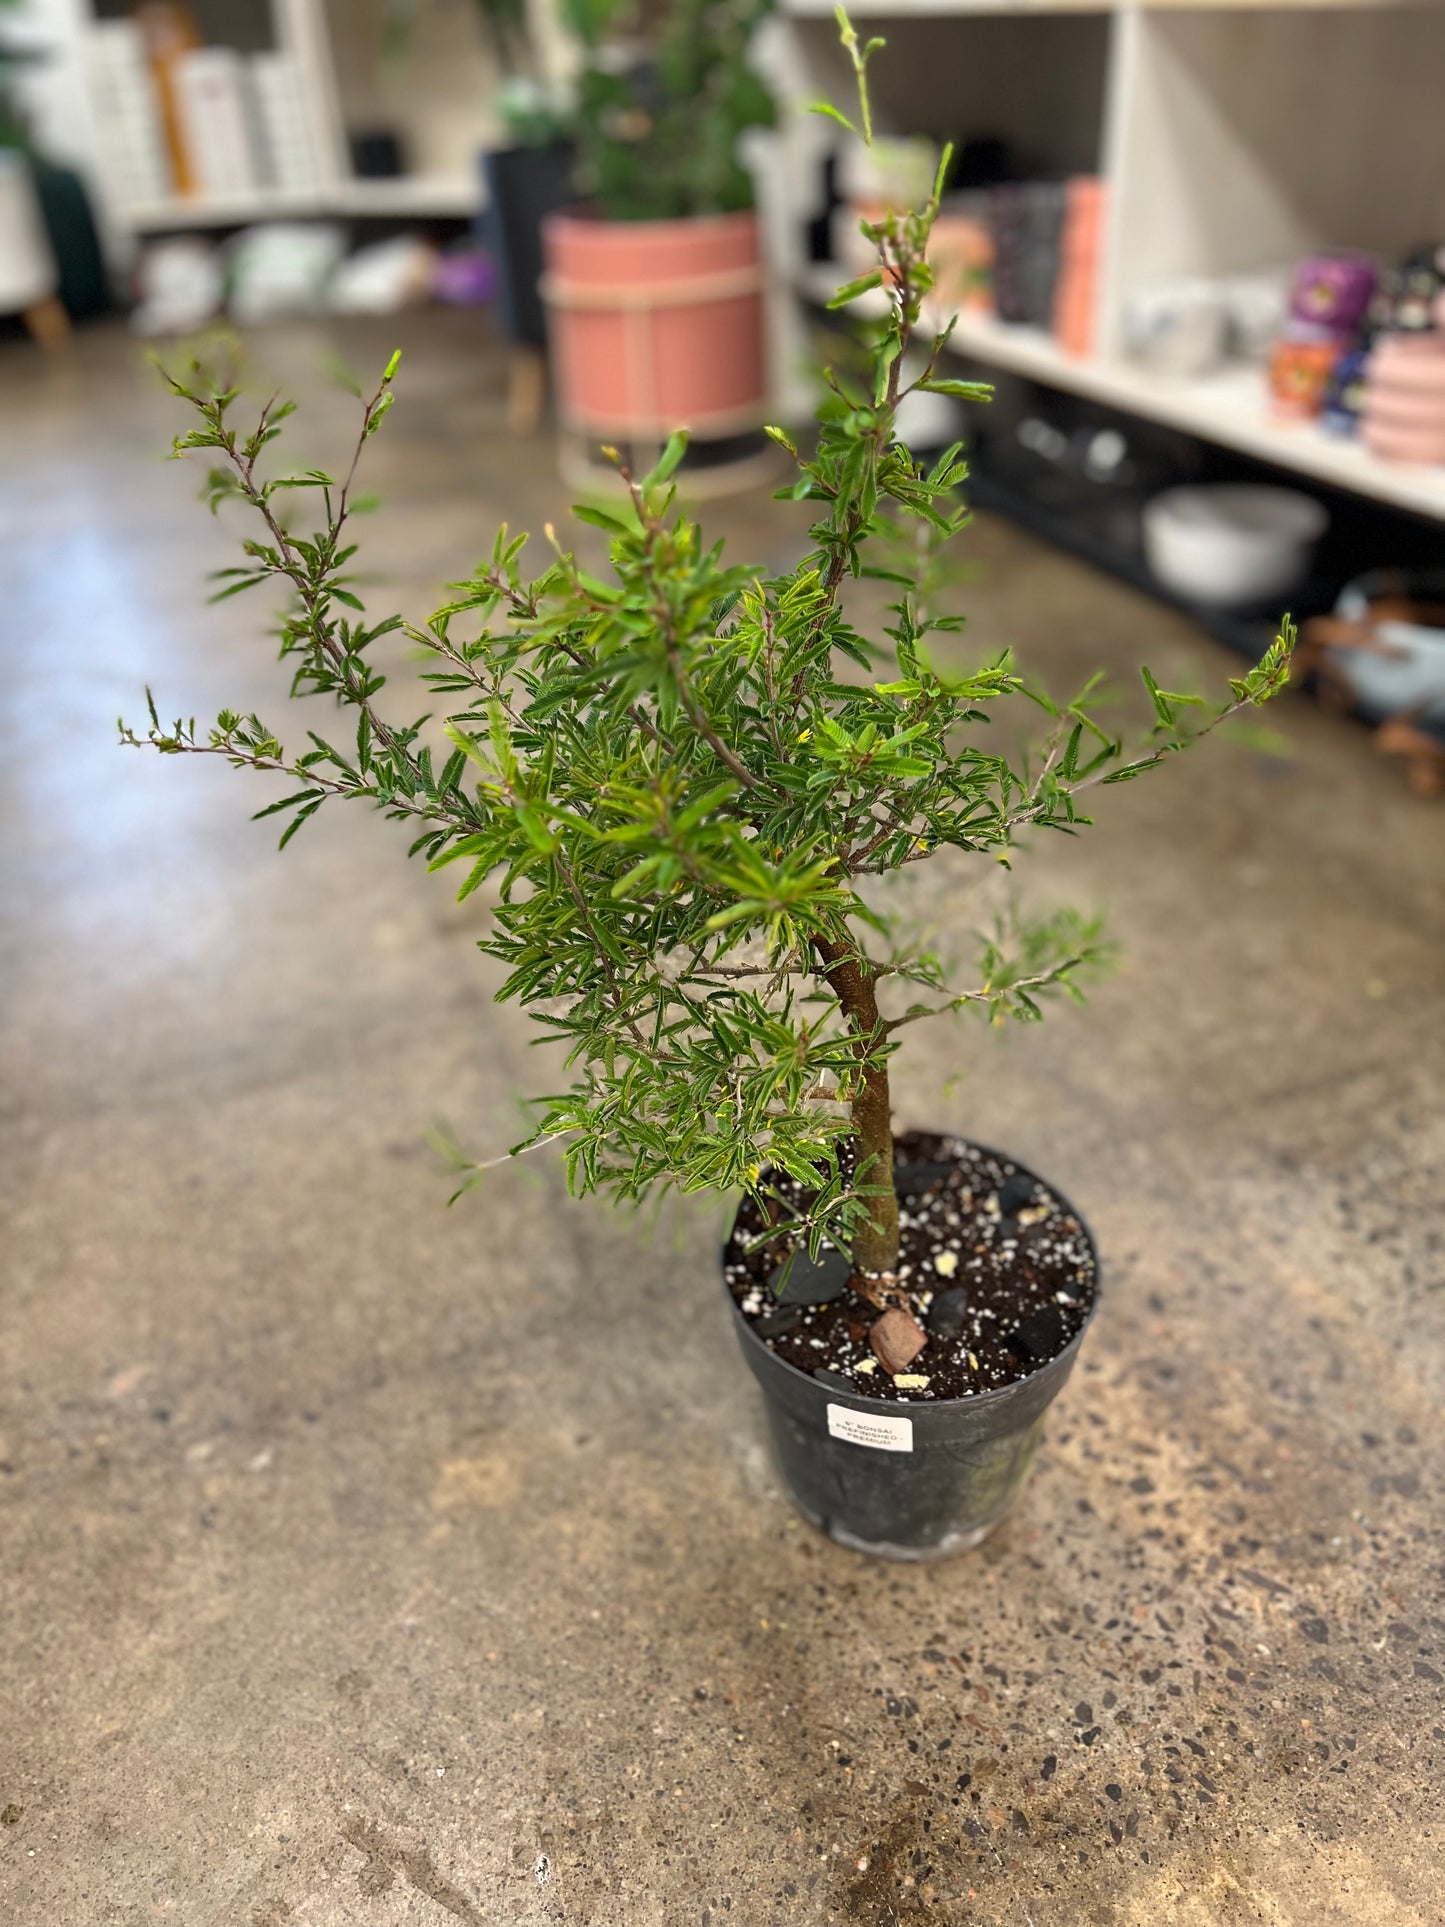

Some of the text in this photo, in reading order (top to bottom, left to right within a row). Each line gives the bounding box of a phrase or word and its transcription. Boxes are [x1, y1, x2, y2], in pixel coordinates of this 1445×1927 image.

[836, 1423, 897, 1440] PREFINISHED
[857, 1424, 892, 1434] BONSAI
[847, 1432, 891, 1445] PREMIUM
